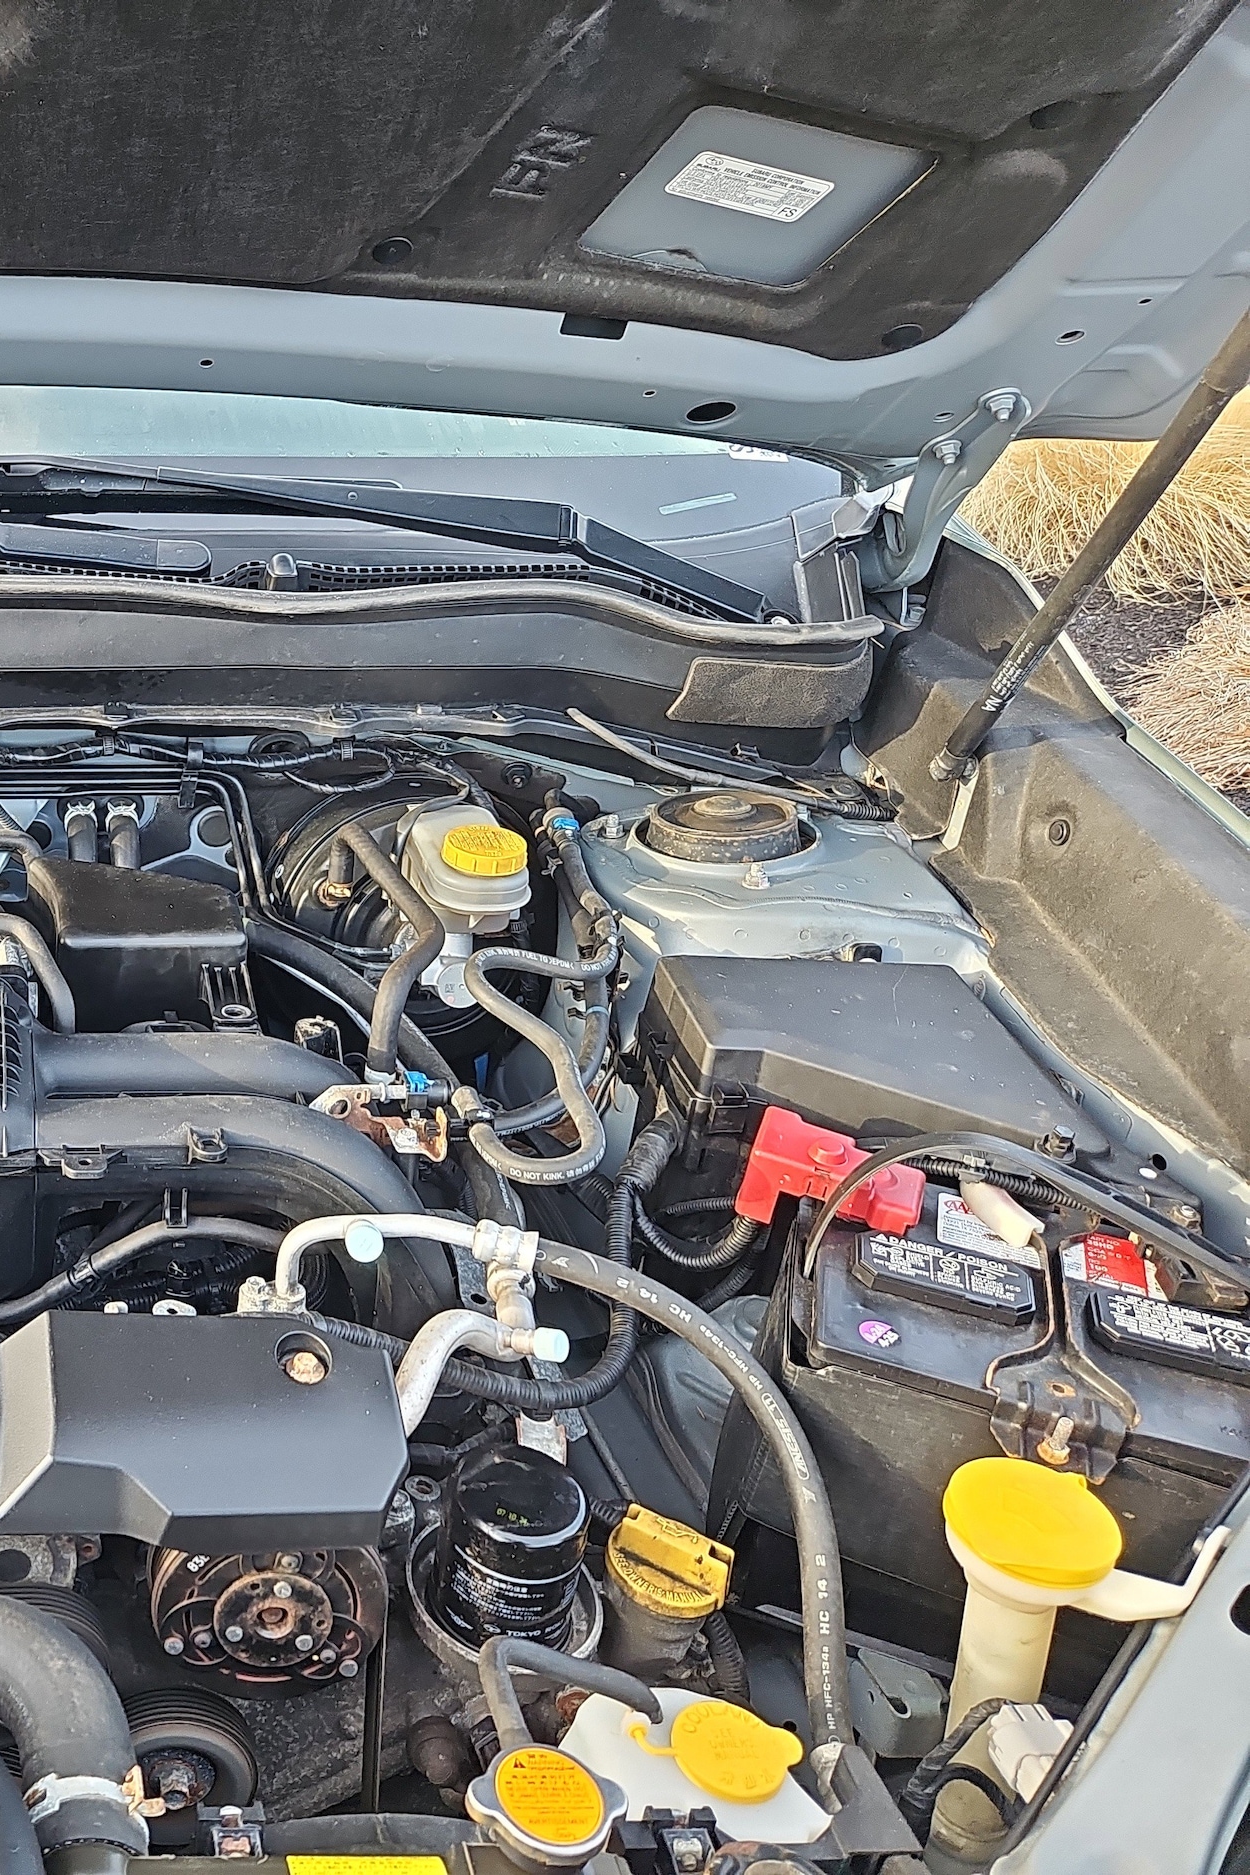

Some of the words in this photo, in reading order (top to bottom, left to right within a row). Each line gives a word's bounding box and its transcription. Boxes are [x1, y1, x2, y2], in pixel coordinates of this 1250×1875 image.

[724, 167, 744, 177] VEHICLE
[743, 173, 766, 182] EMISSION
[767, 178, 788, 188] CONTROL
[788, 183, 822, 195] INFORMATION
[751, 168, 771, 177] SUBARU
[771, 173, 804, 185] CORPORATION
[778, 206, 798, 217] FS
[981, 695, 1003, 711] NA
[521, 950, 539, 961] FUEL
[539, 955, 549, 964] TO
[580, 963, 590, 971] DO
[510, 1168, 522, 1178] DO
[523, 1170, 541, 1180] NOT
[543, 1172, 565, 1181] KINK.
[889, 1236, 943, 1256] DANGER
[956, 1251, 1008, 1271] POISON
[616, 1276, 630, 1289] 2
[639, 1287, 659, 1304] 14
[668, 1303, 693, 1323] HC
[700, 1324, 749, 1373] HFC-134a
[748, 1374, 764, 1391] HP
[815, 1554, 827, 1567] 2
[614, 1552, 628, 1568] SEE
[665, 1590, 705, 1603] MANUAL
[817, 1578, 829, 1600] 14
[819, 1610, 831, 1636] HC
[506, 1629, 541, 1638] TOKYO
[821, 1646, 833, 1708] HFC-134a
[826, 1713, 837, 1731] HP
